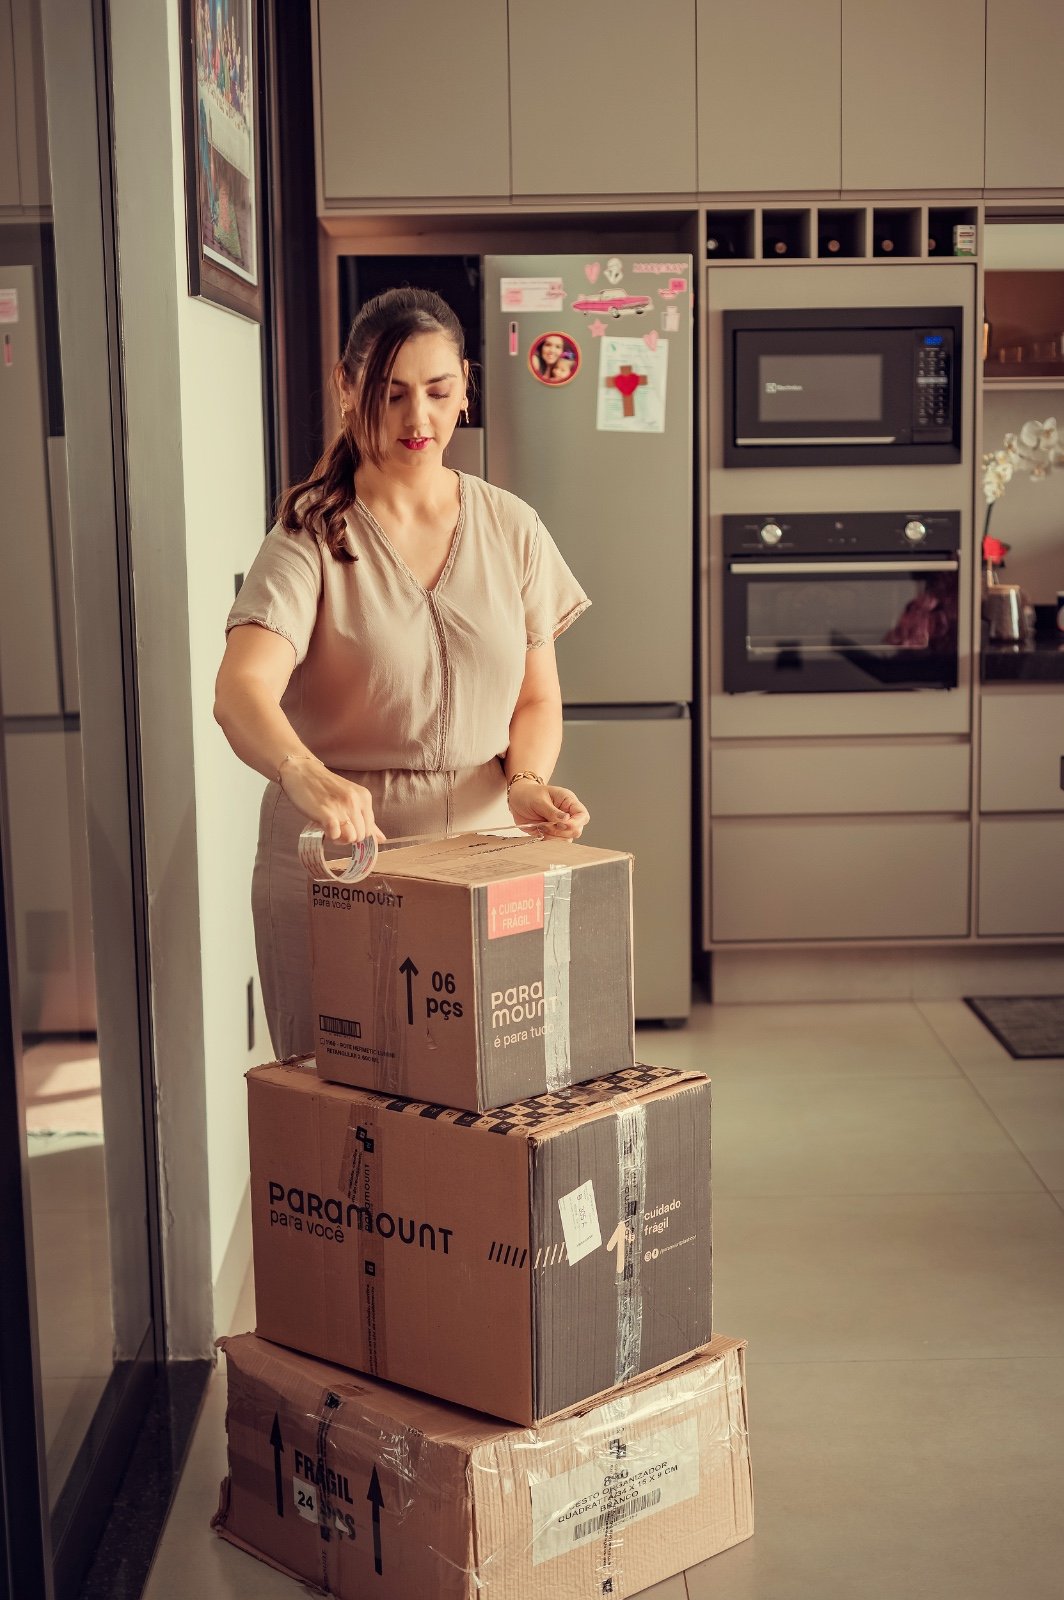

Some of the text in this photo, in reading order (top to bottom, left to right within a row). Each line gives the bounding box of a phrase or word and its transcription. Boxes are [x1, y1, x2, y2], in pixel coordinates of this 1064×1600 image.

[313, 898, 331, 908] para
[499, 898, 534, 916] CUIDADO
[502, 914, 531, 931] FRÁGIL
[432, 971, 456, 994] 06
[426, 997, 464, 1021] pçs
[494, 1035, 501, 1048] é
[504, 1028, 528, 1049] para
[644, 1199, 681, 1221] cuidado
[270, 1208, 345, 1243] para você
[644, 1217, 669, 1237] frágil
[602, 1461, 668, 1495] ORGANIZADOR
[629, 1483, 635, 1491] X
[664, 1464, 679, 1475] CM
[297, 1490, 314, 1511] 24
[600, 1490, 639, 1512] BRANCO
